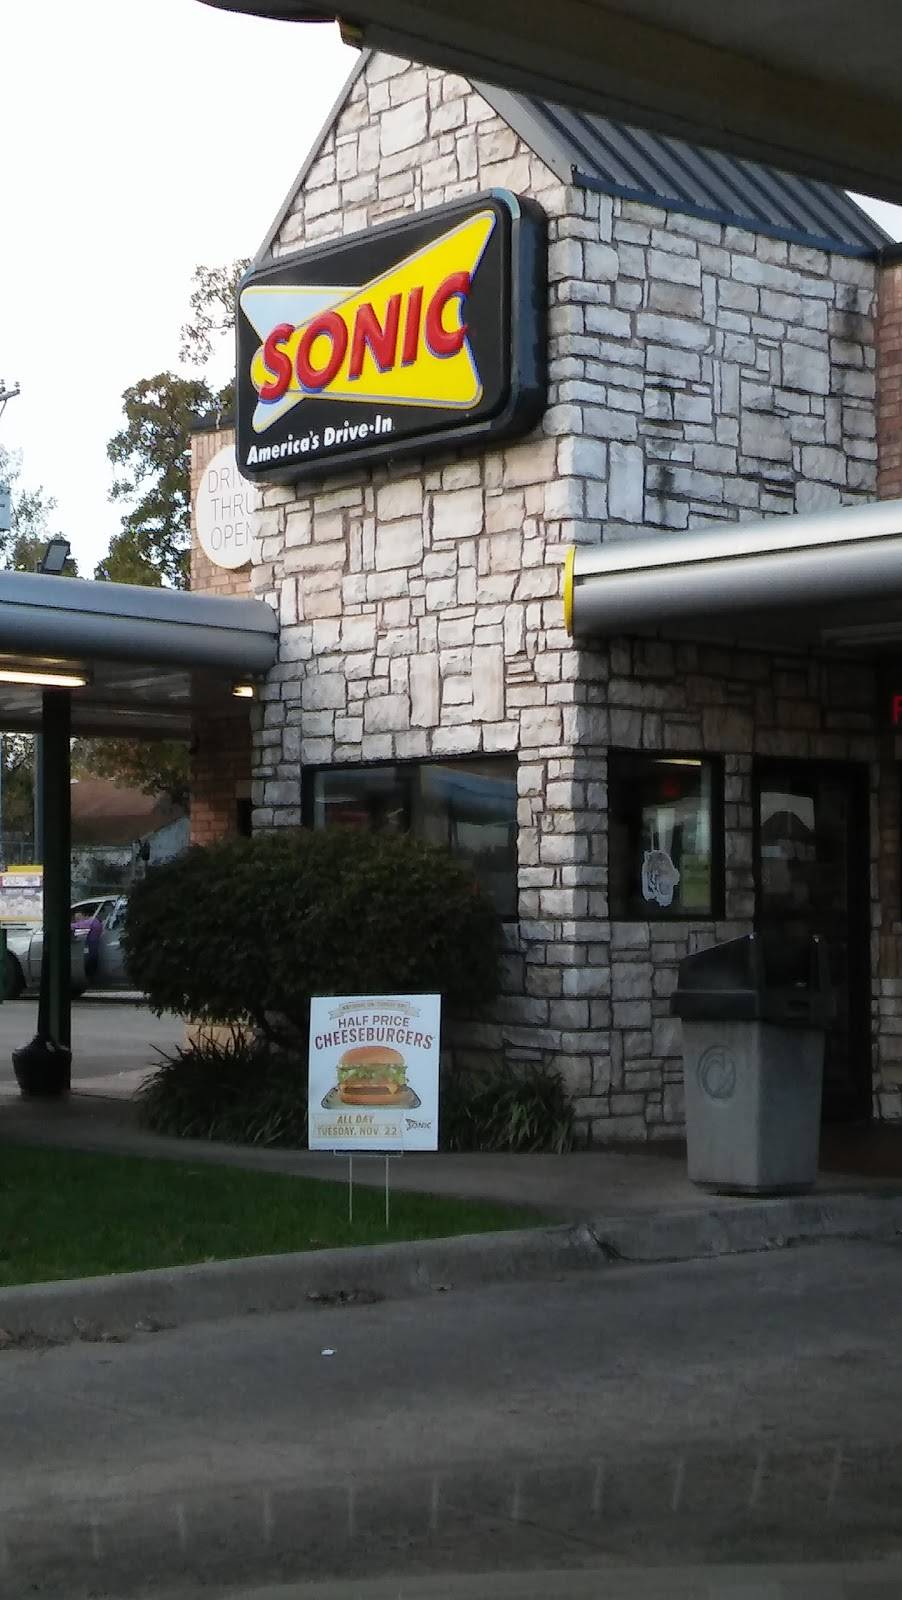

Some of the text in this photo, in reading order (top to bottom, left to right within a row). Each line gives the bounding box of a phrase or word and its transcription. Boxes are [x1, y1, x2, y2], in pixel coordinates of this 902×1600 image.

[258, 271, 471, 405] SONIC
[246, 432, 320, 465] America's
[338, 1015, 410, 1028] HALF PRICE
[315, 1028, 433, 1050] CHEESEBURGERS
[337, 1114, 374, 1124] ALL DAY
[405, 1118, 432, 1130] SONIC
